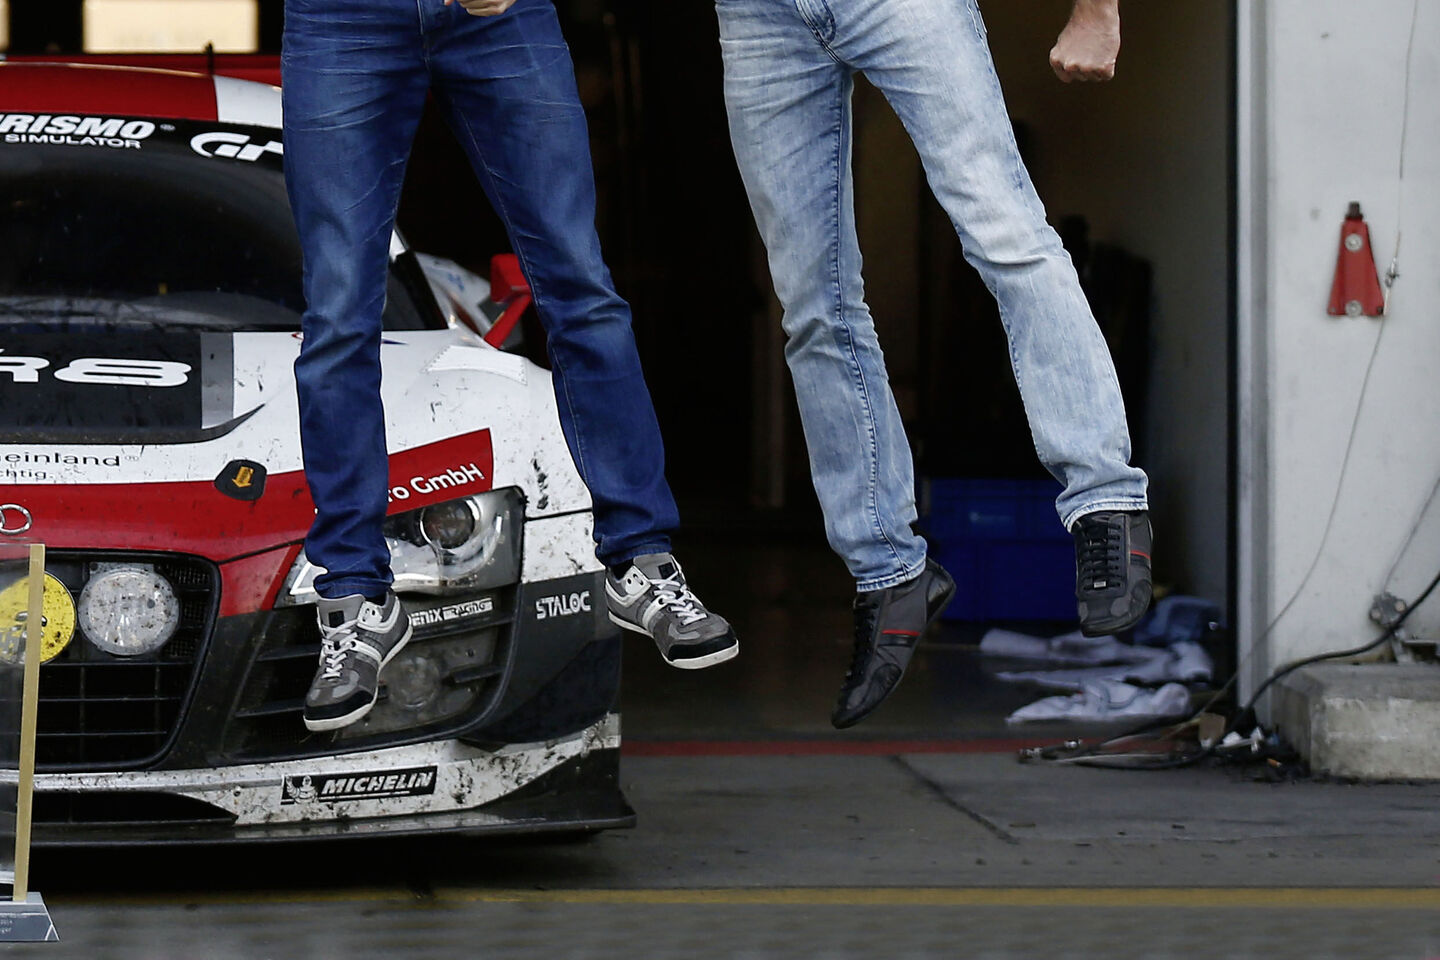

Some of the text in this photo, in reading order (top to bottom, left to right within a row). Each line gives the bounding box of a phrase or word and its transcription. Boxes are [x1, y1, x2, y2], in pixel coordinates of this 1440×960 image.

[4, 133, 141, 150] SIMULATOR
[410, 463, 484, 494] GmbH
[536, 591, 591, 619] STALOC
[321, 772, 434, 795] MICHELIN
